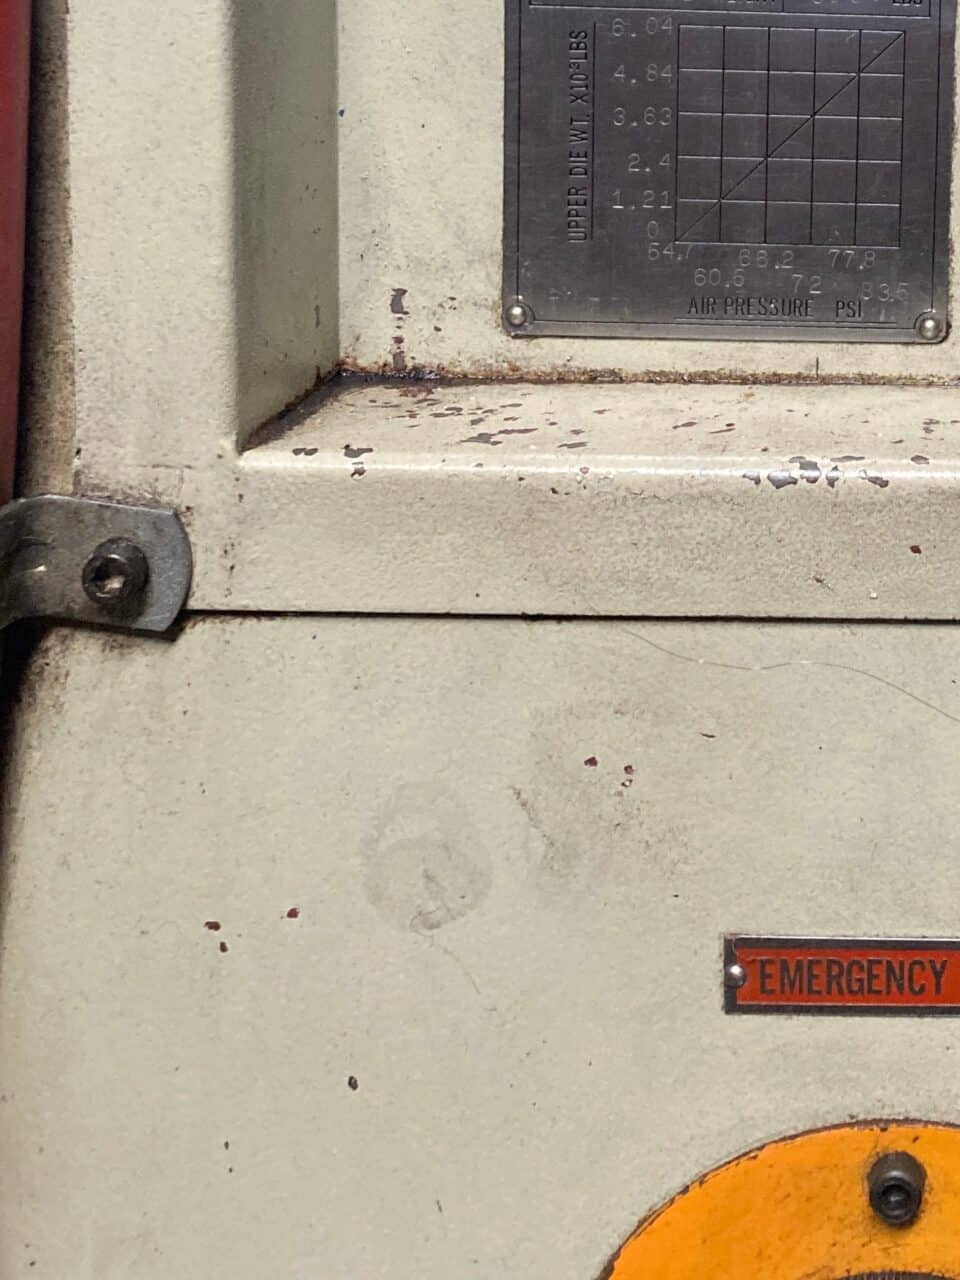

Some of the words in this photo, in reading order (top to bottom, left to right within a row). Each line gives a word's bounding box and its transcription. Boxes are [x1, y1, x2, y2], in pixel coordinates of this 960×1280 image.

[612, 17, 672, 37] 6.04
[614, 63, 672, 83] 4.84
[613, 106, 672, 126] 3.63
[570, 114, 591, 145] WT.
[569, 151, 588, 178] DIE
[627, 152, 670, 172] 2.4
[611, 188, 672, 210] 1.21
[568, 186, 587, 243] UPPER
[647, 220, 659, 238] 0
[648, 241, 694, 261] 54.7
[828, 249, 876, 269] 77.8
[791, 274, 822, 295] 72
[687, 295, 717, 315] AIR
[723, 296, 814, 318] PRESSURE
[835, 300, 862, 318] PSI
[759, 957, 948, 996] EMERGENCY
